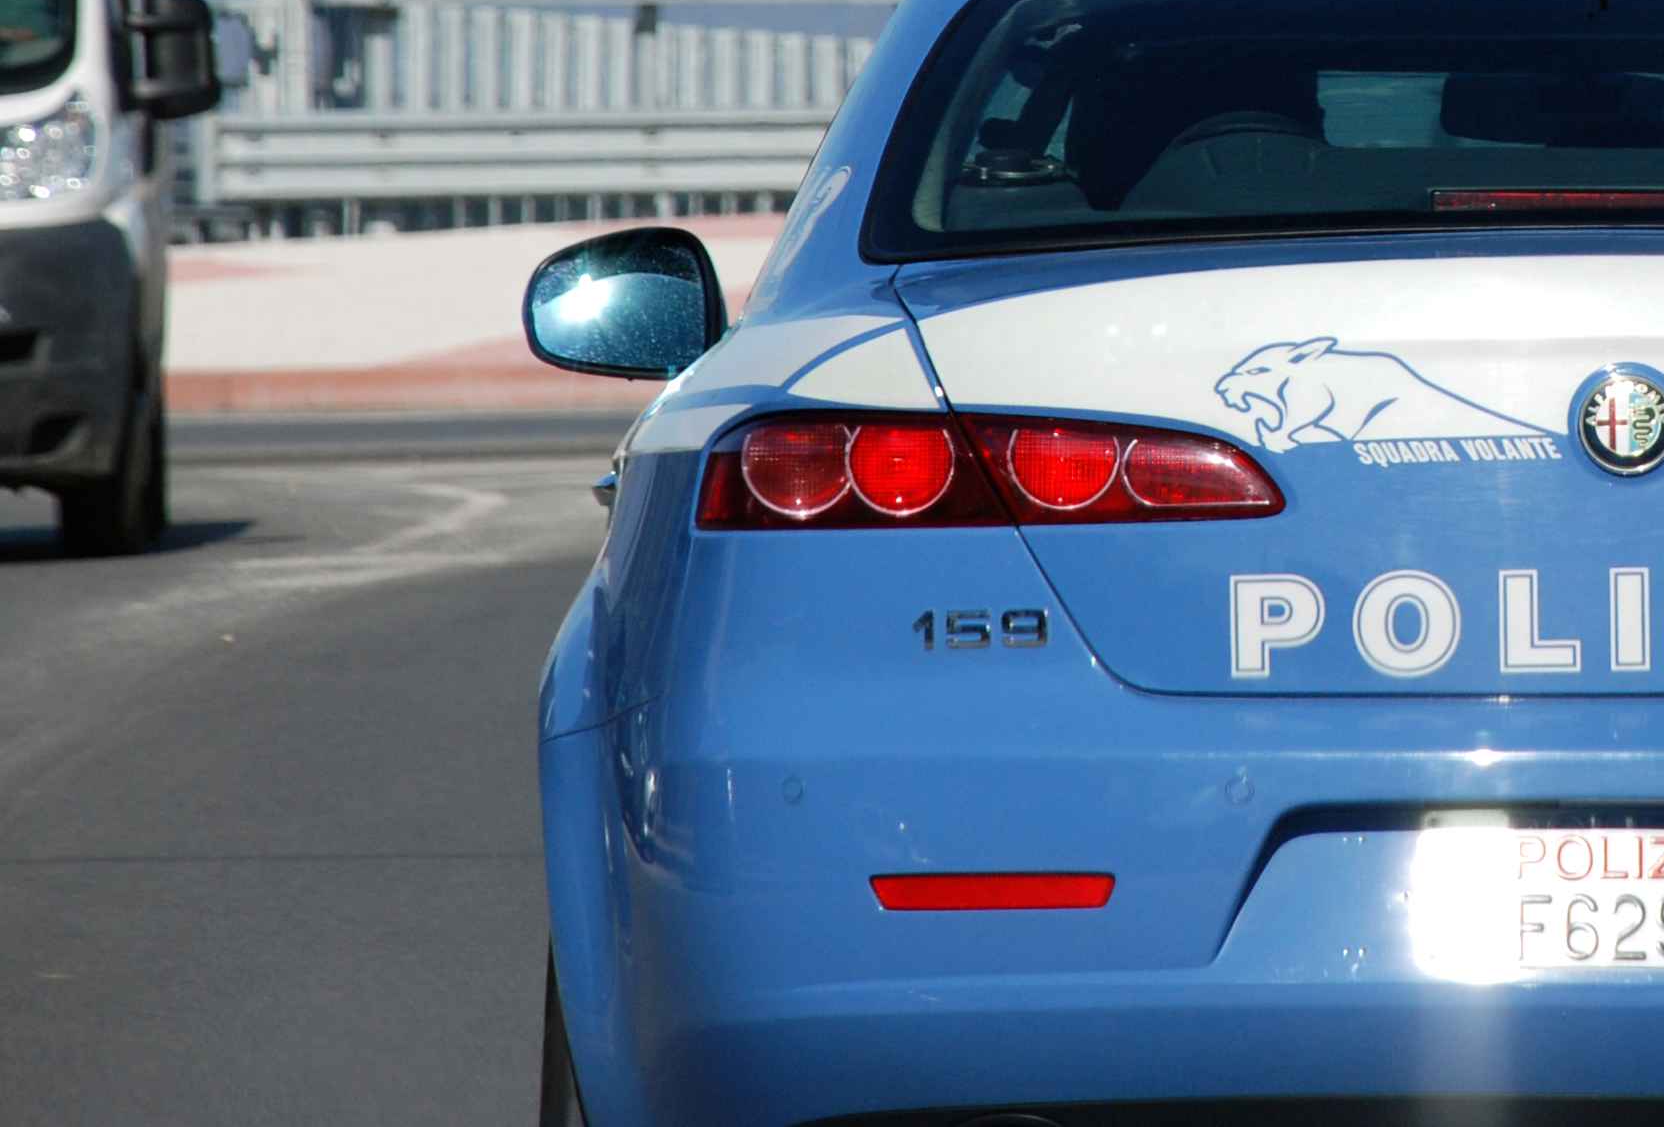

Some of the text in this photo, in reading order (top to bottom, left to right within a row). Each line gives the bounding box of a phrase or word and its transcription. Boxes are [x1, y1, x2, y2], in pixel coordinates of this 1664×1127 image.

[1353, 437, 1562, 468] SQUADRA VOLANTE
[912, 609, 1048, 650] 159
